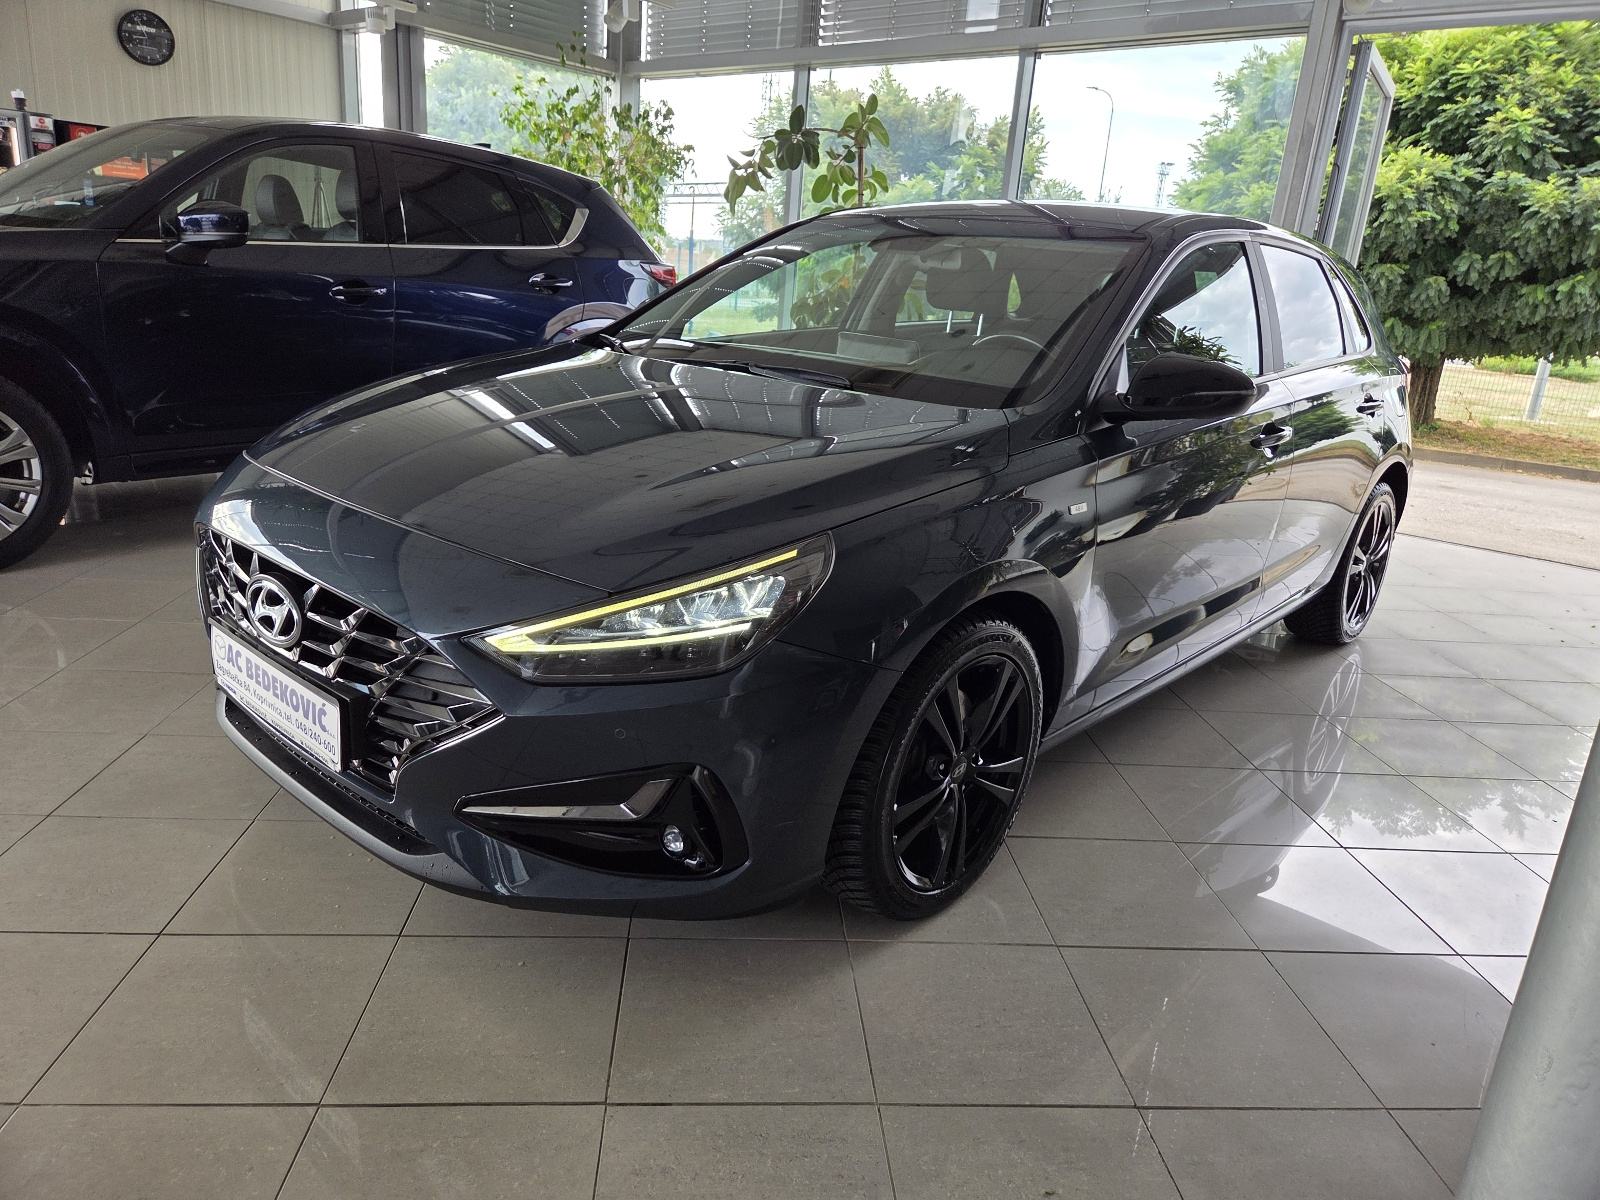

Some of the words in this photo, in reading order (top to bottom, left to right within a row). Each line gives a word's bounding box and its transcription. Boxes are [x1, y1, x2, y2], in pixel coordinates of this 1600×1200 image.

[226, 644, 243, 673] AC
[246, 656, 328, 733] BEDEKOVIĆ
[295, 719, 336, 756] 048/240-600
